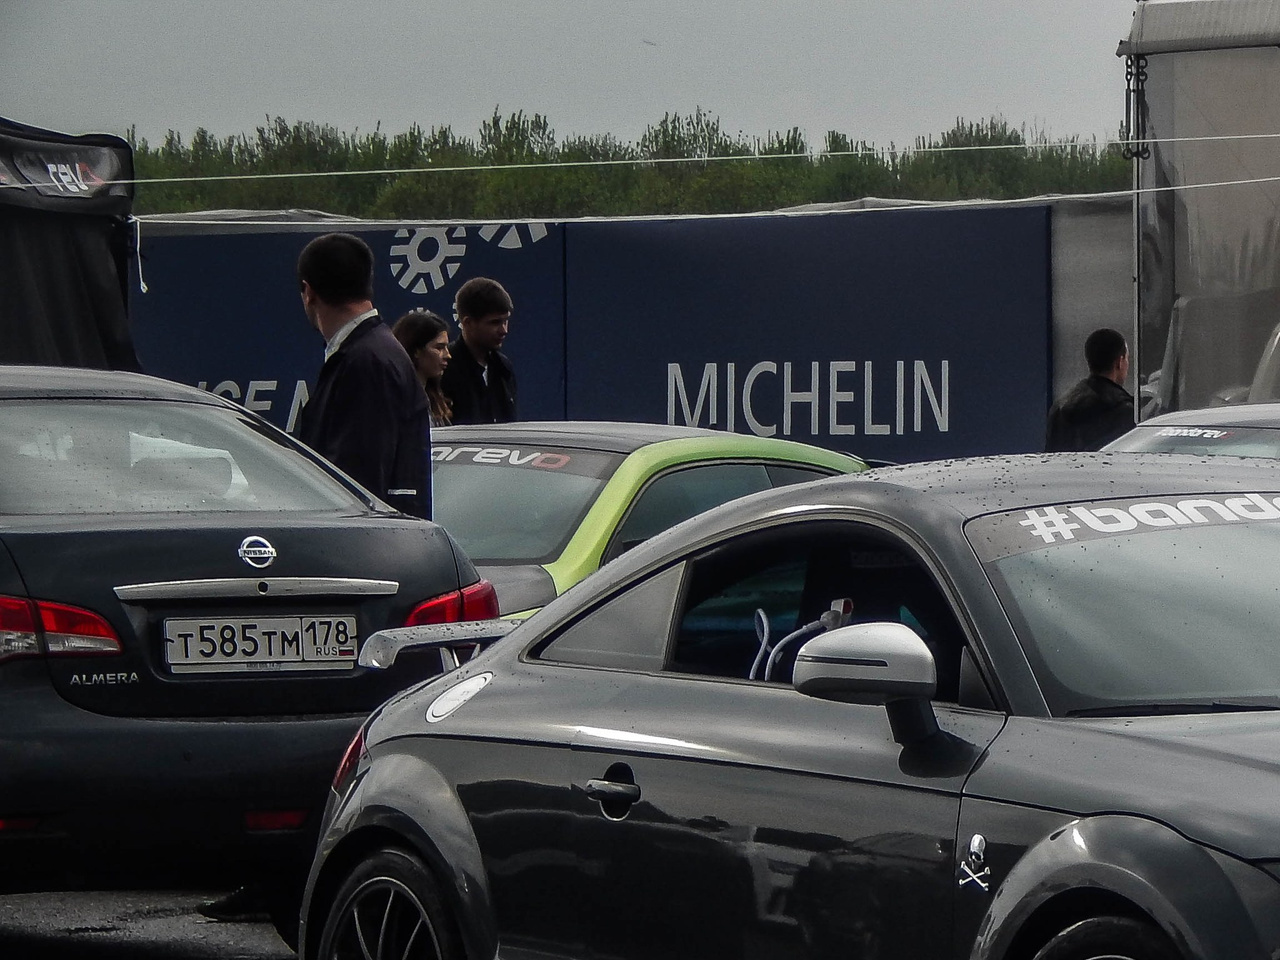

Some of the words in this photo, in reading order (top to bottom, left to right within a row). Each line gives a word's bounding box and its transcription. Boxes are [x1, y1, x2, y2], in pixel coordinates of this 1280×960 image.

[667, 360, 949, 437] MICHELIN
[304, 620, 349, 647] 178
[315, 646, 338, 657] RUS
[70, 672, 140, 686] ALMERA
